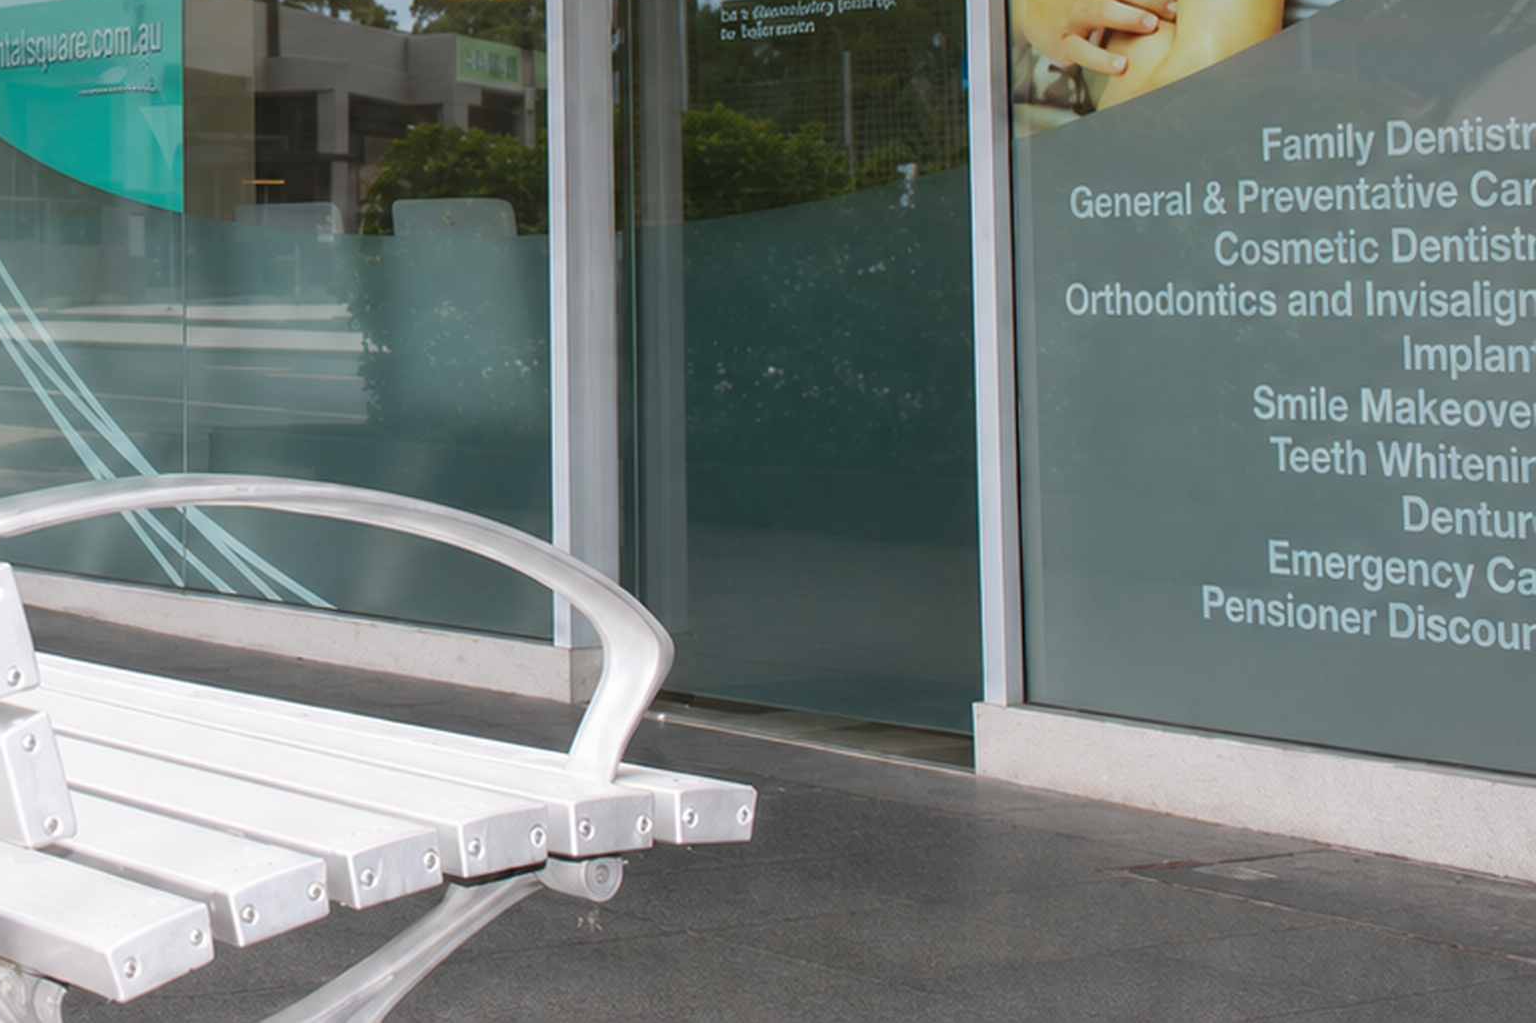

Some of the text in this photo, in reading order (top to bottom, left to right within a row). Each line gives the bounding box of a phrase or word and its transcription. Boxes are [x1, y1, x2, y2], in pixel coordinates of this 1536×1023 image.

[1262, 116, 1536, 166] Family Dentistr
[1069, 169, 1536, 219] General & Preventative Car
[1214, 225, 1536, 267] Cosmetic Dentistr
[1065, 282, 1278, 317] Orthodontics
[1287, 281, 1354, 318] and
[1403, 334, 1536, 381] Implan
[1253, 384, 1536, 430] Smile Makeove
[1269, 436, 1536, 484] Teeth Whitenin
[1402, 494, 1536, 540] Dentur
[1268, 539, 1536, 600] Emergency Ca
[1201, 584, 1536, 652] Pensioner Discoun
